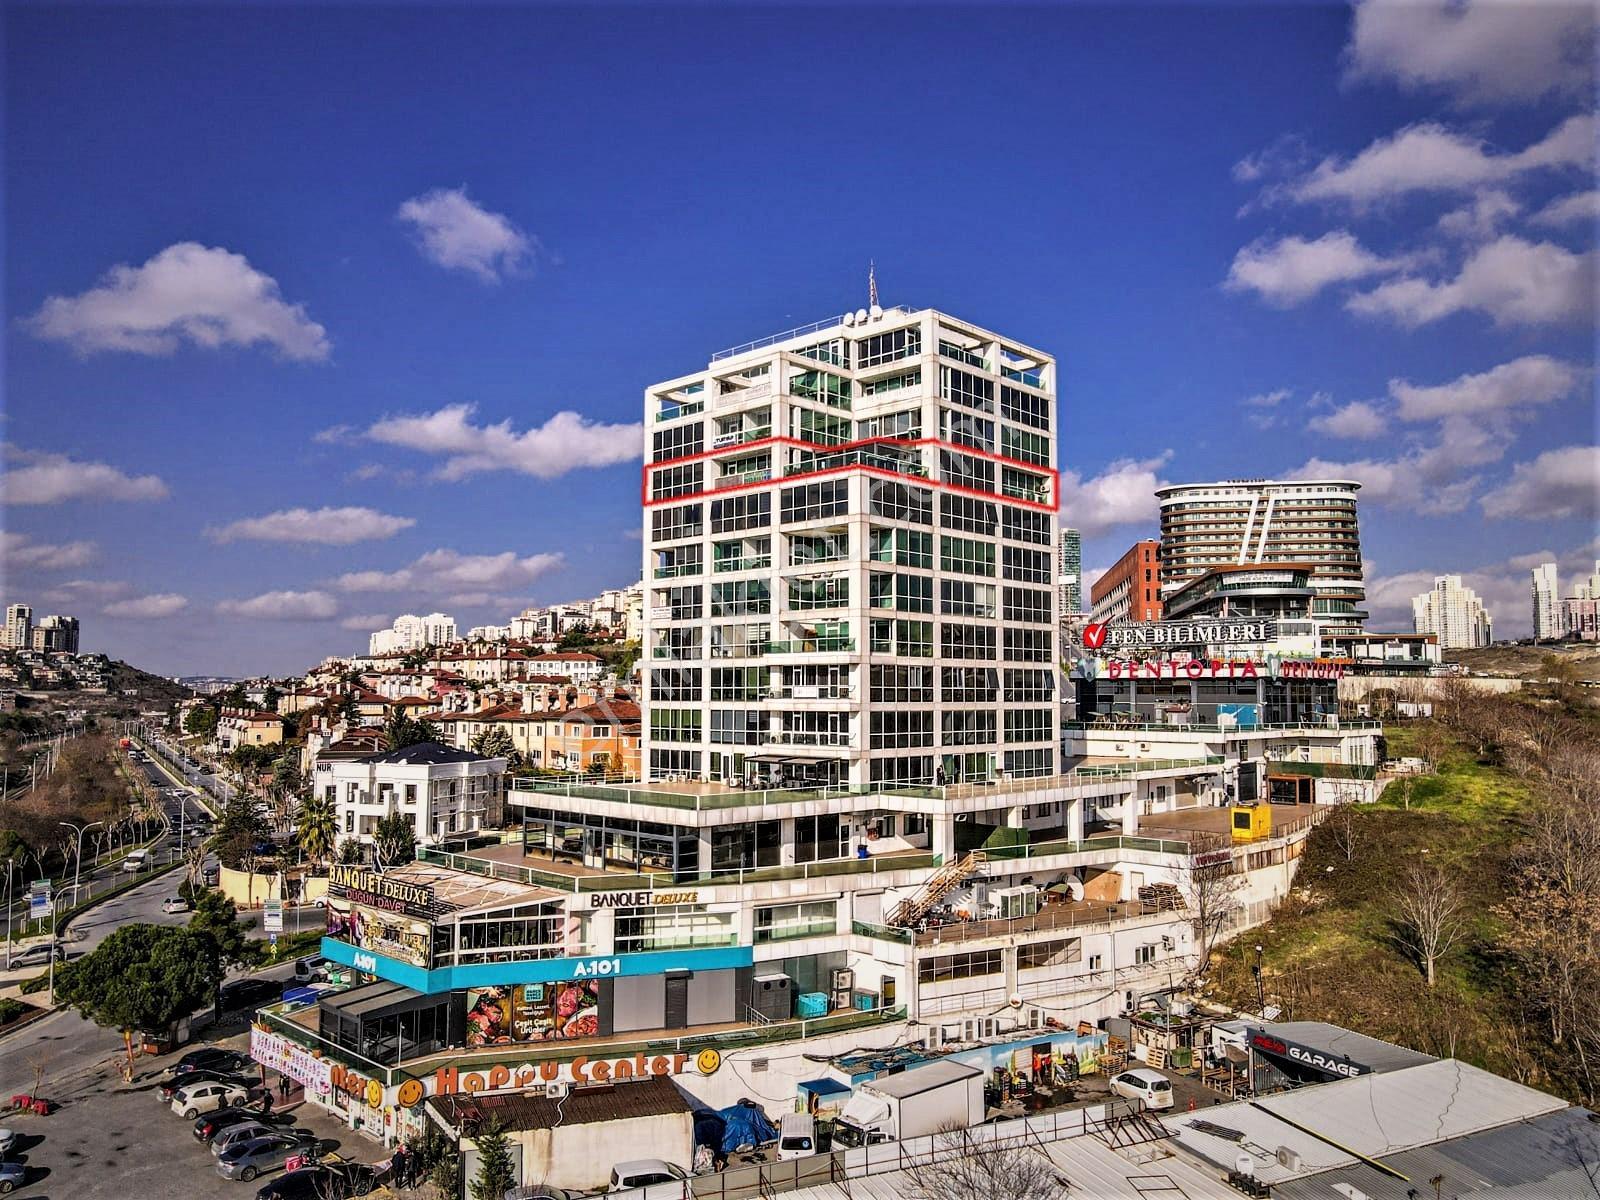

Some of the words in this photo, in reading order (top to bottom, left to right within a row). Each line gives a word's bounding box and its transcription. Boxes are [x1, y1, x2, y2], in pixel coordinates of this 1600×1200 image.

[1111, 628, 1147, 644] FEN
[1109, 659, 1258, 680] DENTOPIA
[1282, 661, 1345, 679] DENTOPIA
[329, 865, 382, 895] BANQUET
[384, 882, 429, 906] DELUXE
[591, 892, 653, 908] BANQUET
[653, 892, 699, 905] DELUXE
[571, 1052, 688, 1082] Center
[1290, 1047, 1360, 1077] GARAGE
